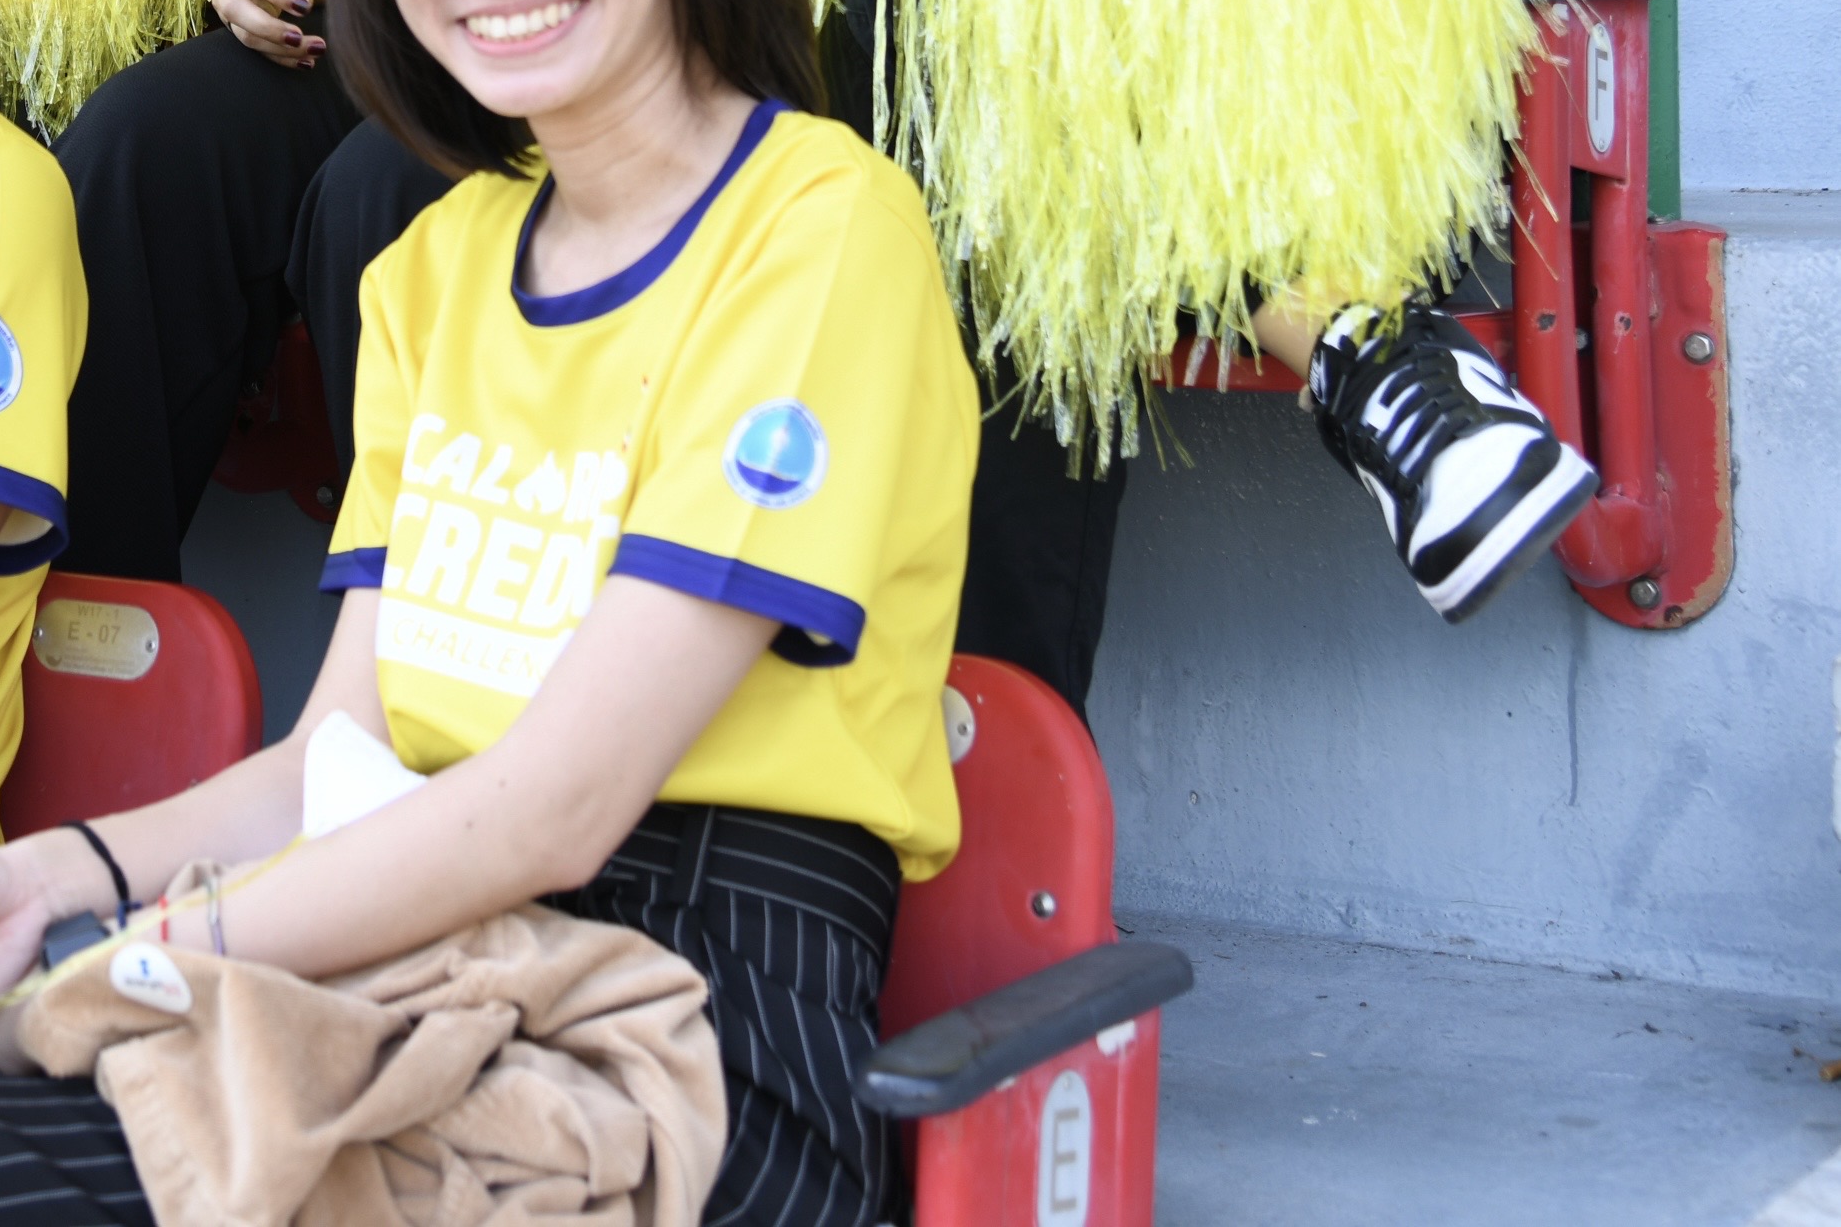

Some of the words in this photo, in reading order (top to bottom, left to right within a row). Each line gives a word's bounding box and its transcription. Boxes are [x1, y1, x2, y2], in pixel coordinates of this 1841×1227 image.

[1594, 48, 1608, 121] F
[392, 617, 544, 679] CHALLEN
[1050, 1106, 1080, 1215] E
